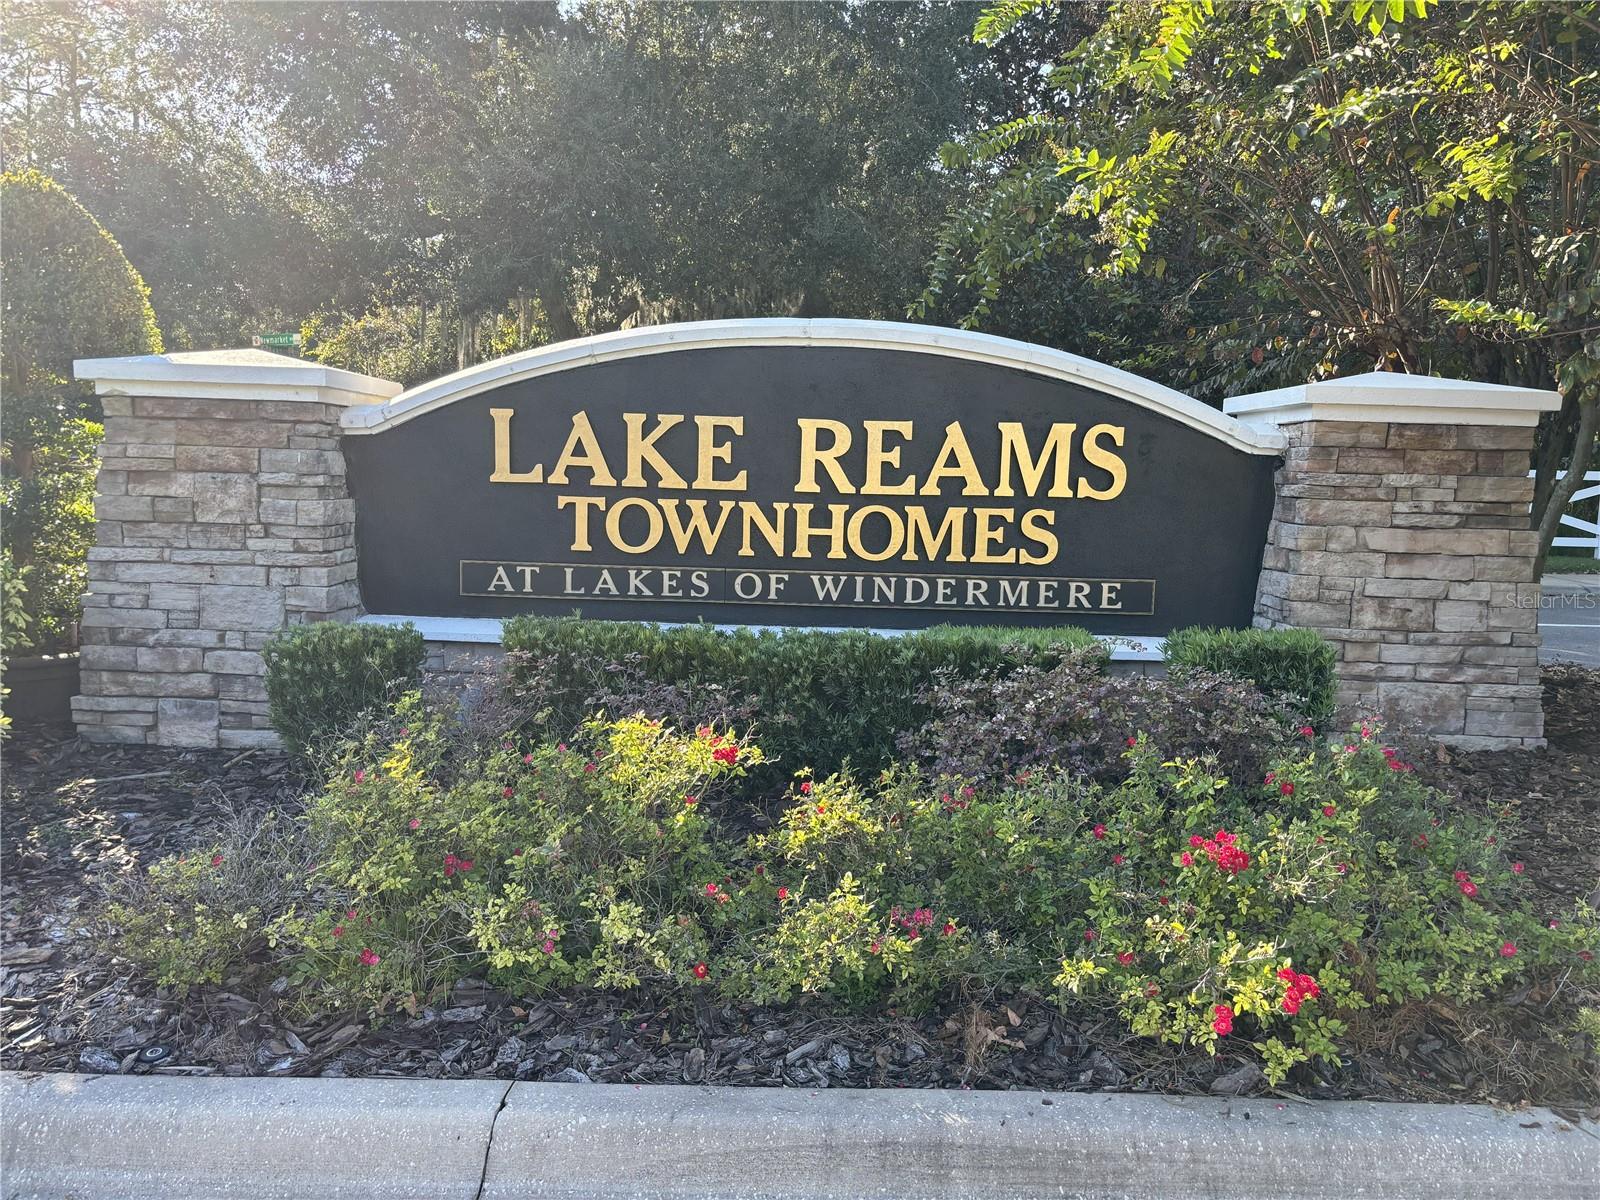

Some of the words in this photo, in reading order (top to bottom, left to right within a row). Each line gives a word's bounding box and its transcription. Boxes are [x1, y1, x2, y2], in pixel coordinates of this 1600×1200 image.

[490, 408, 747, 490] LAKE
[794, 418, 1127, 500] REAMS
[558, 495, 1058, 565] TOWNHOMES
[487, 565, 540, 592] AT
[563, 568, 709, 597] LAKES
[734, 573, 789, 599] OF
[810, 575, 1122, 609] WINDERMERE
